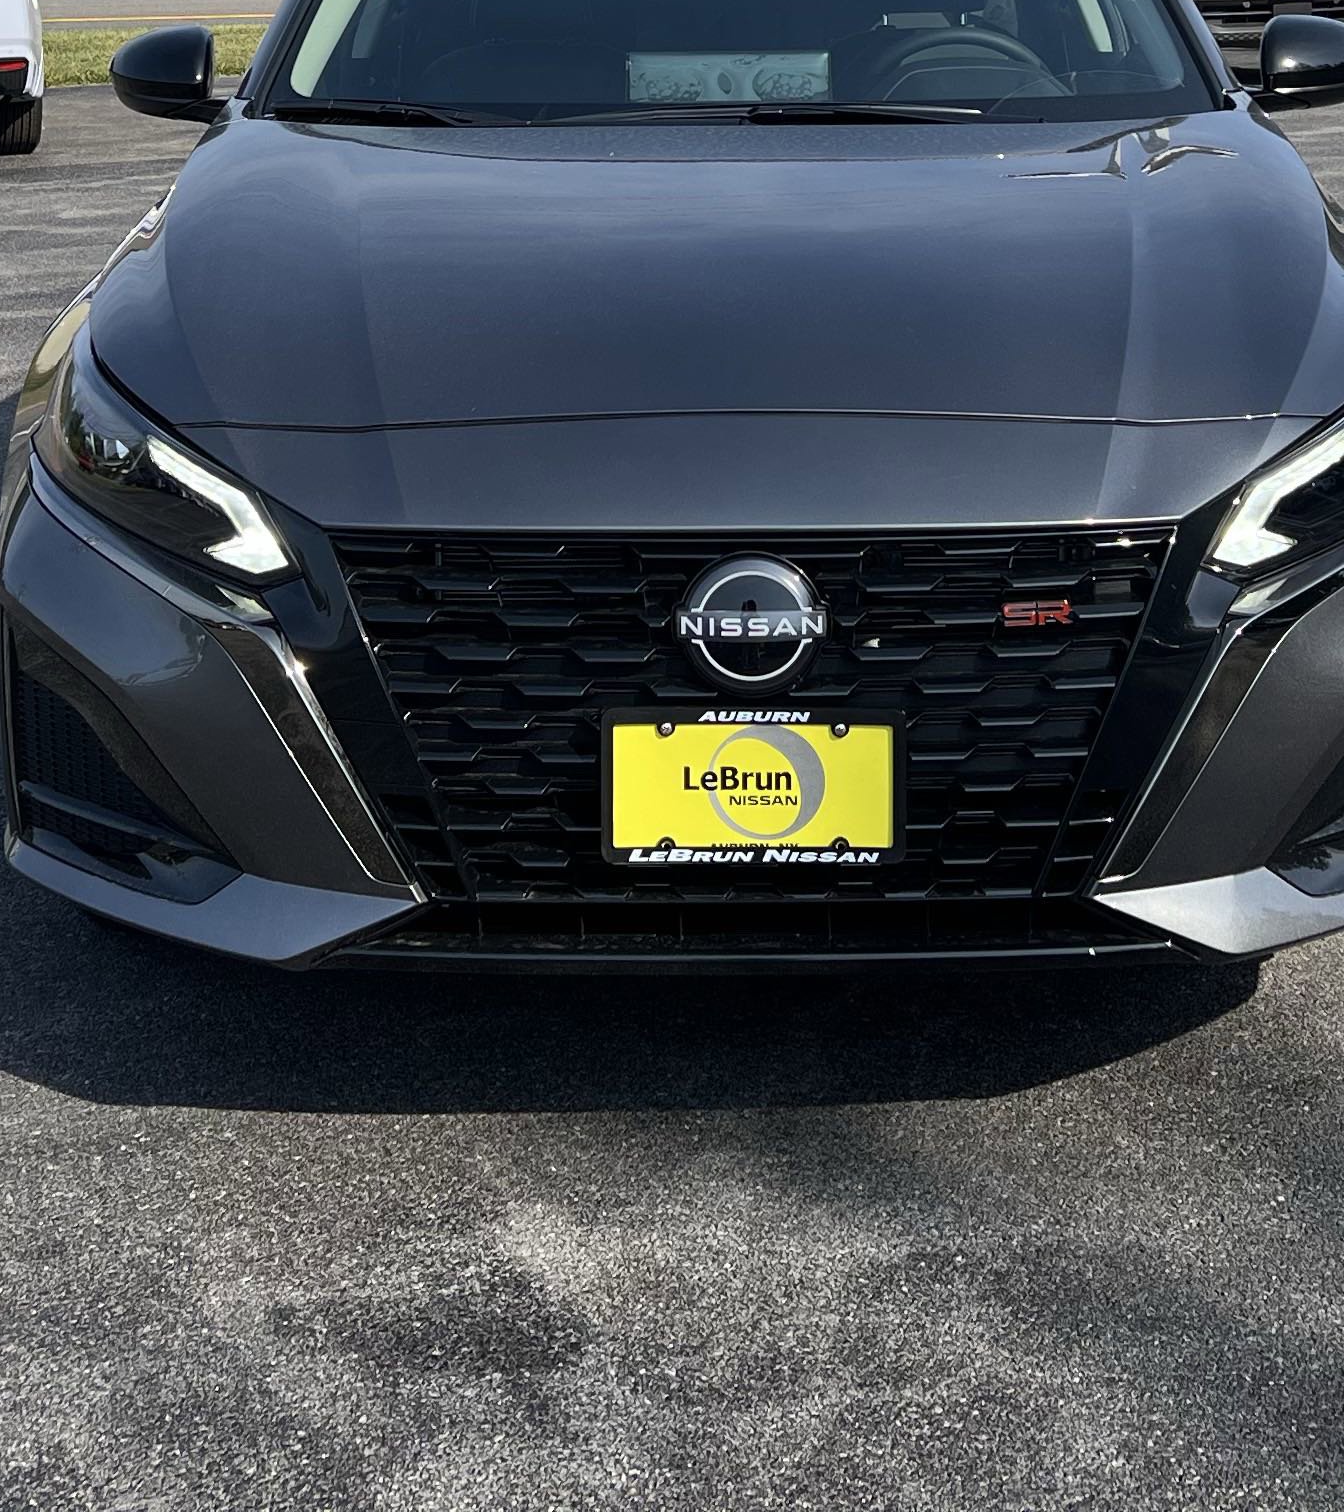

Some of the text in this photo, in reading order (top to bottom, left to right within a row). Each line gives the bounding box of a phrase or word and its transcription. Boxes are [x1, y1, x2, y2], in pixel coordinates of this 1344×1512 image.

[1002, 599, 1073, 627] SR
[680, 615, 824, 637] NISSAN
[698, 710, 811, 723] AUBURN
[683, 766, 792, 791] LeBrun
[729, 795, 798, 806] NISSAN
